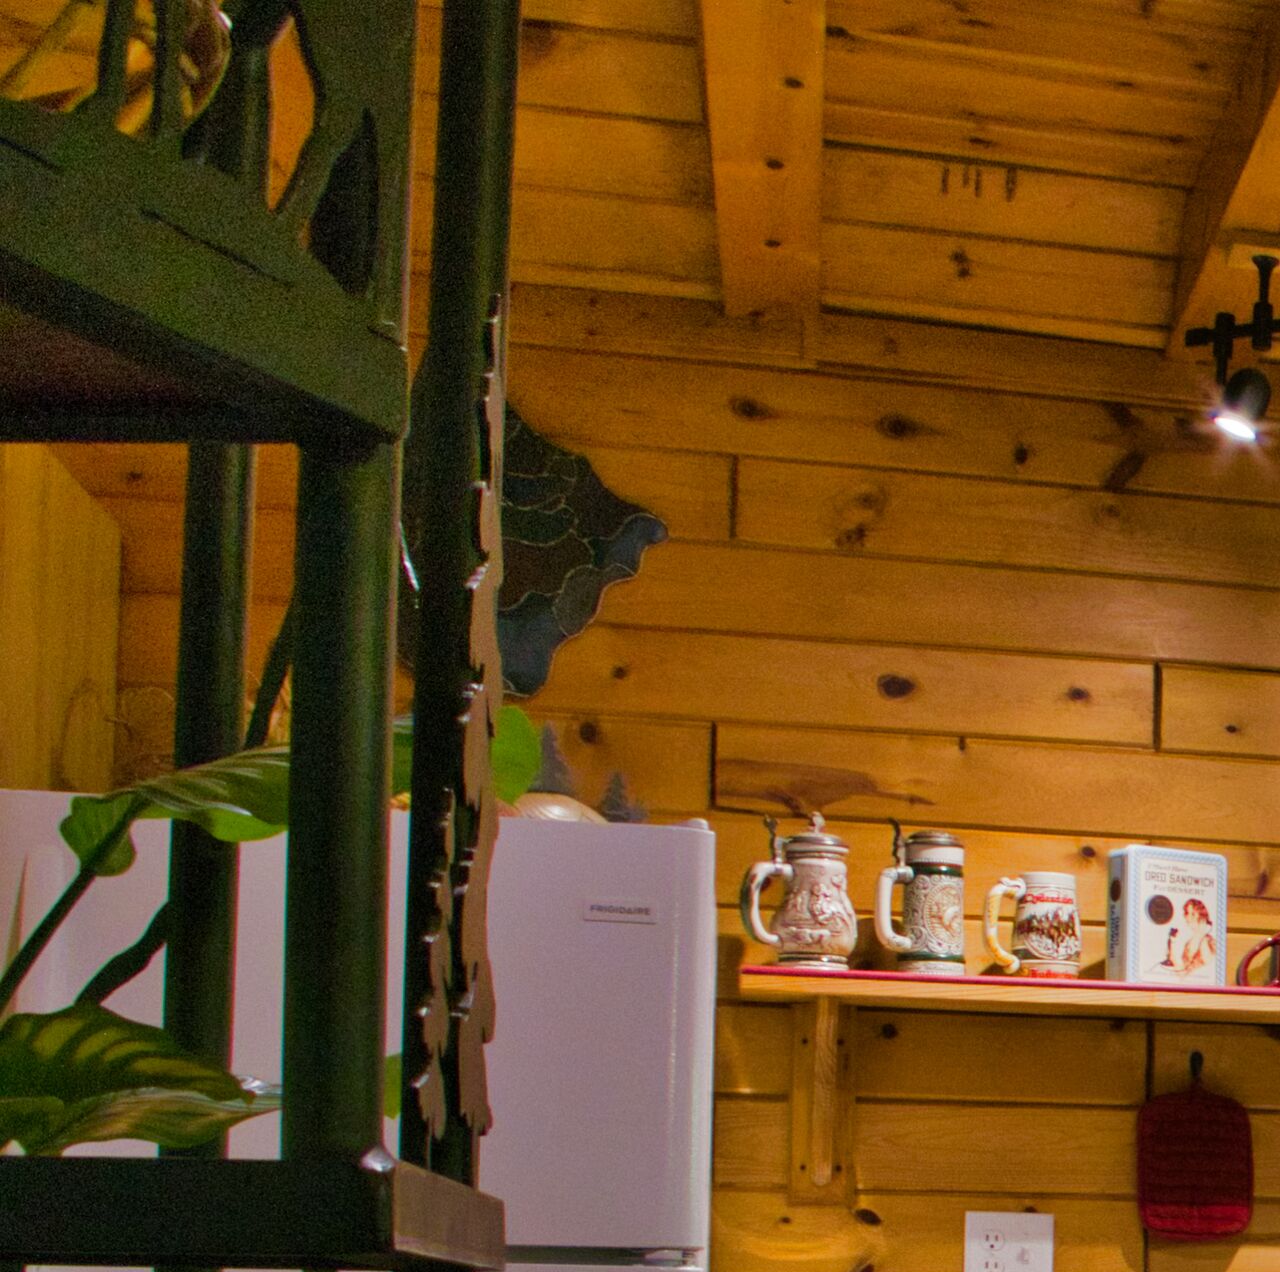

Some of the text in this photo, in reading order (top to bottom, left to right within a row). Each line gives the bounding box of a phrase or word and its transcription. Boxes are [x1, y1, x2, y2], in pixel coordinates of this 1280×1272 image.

[1144, 871, 1215, 889] OREO SANDWICH
[590, 904, 651, 915] FRIGIDAIRE
